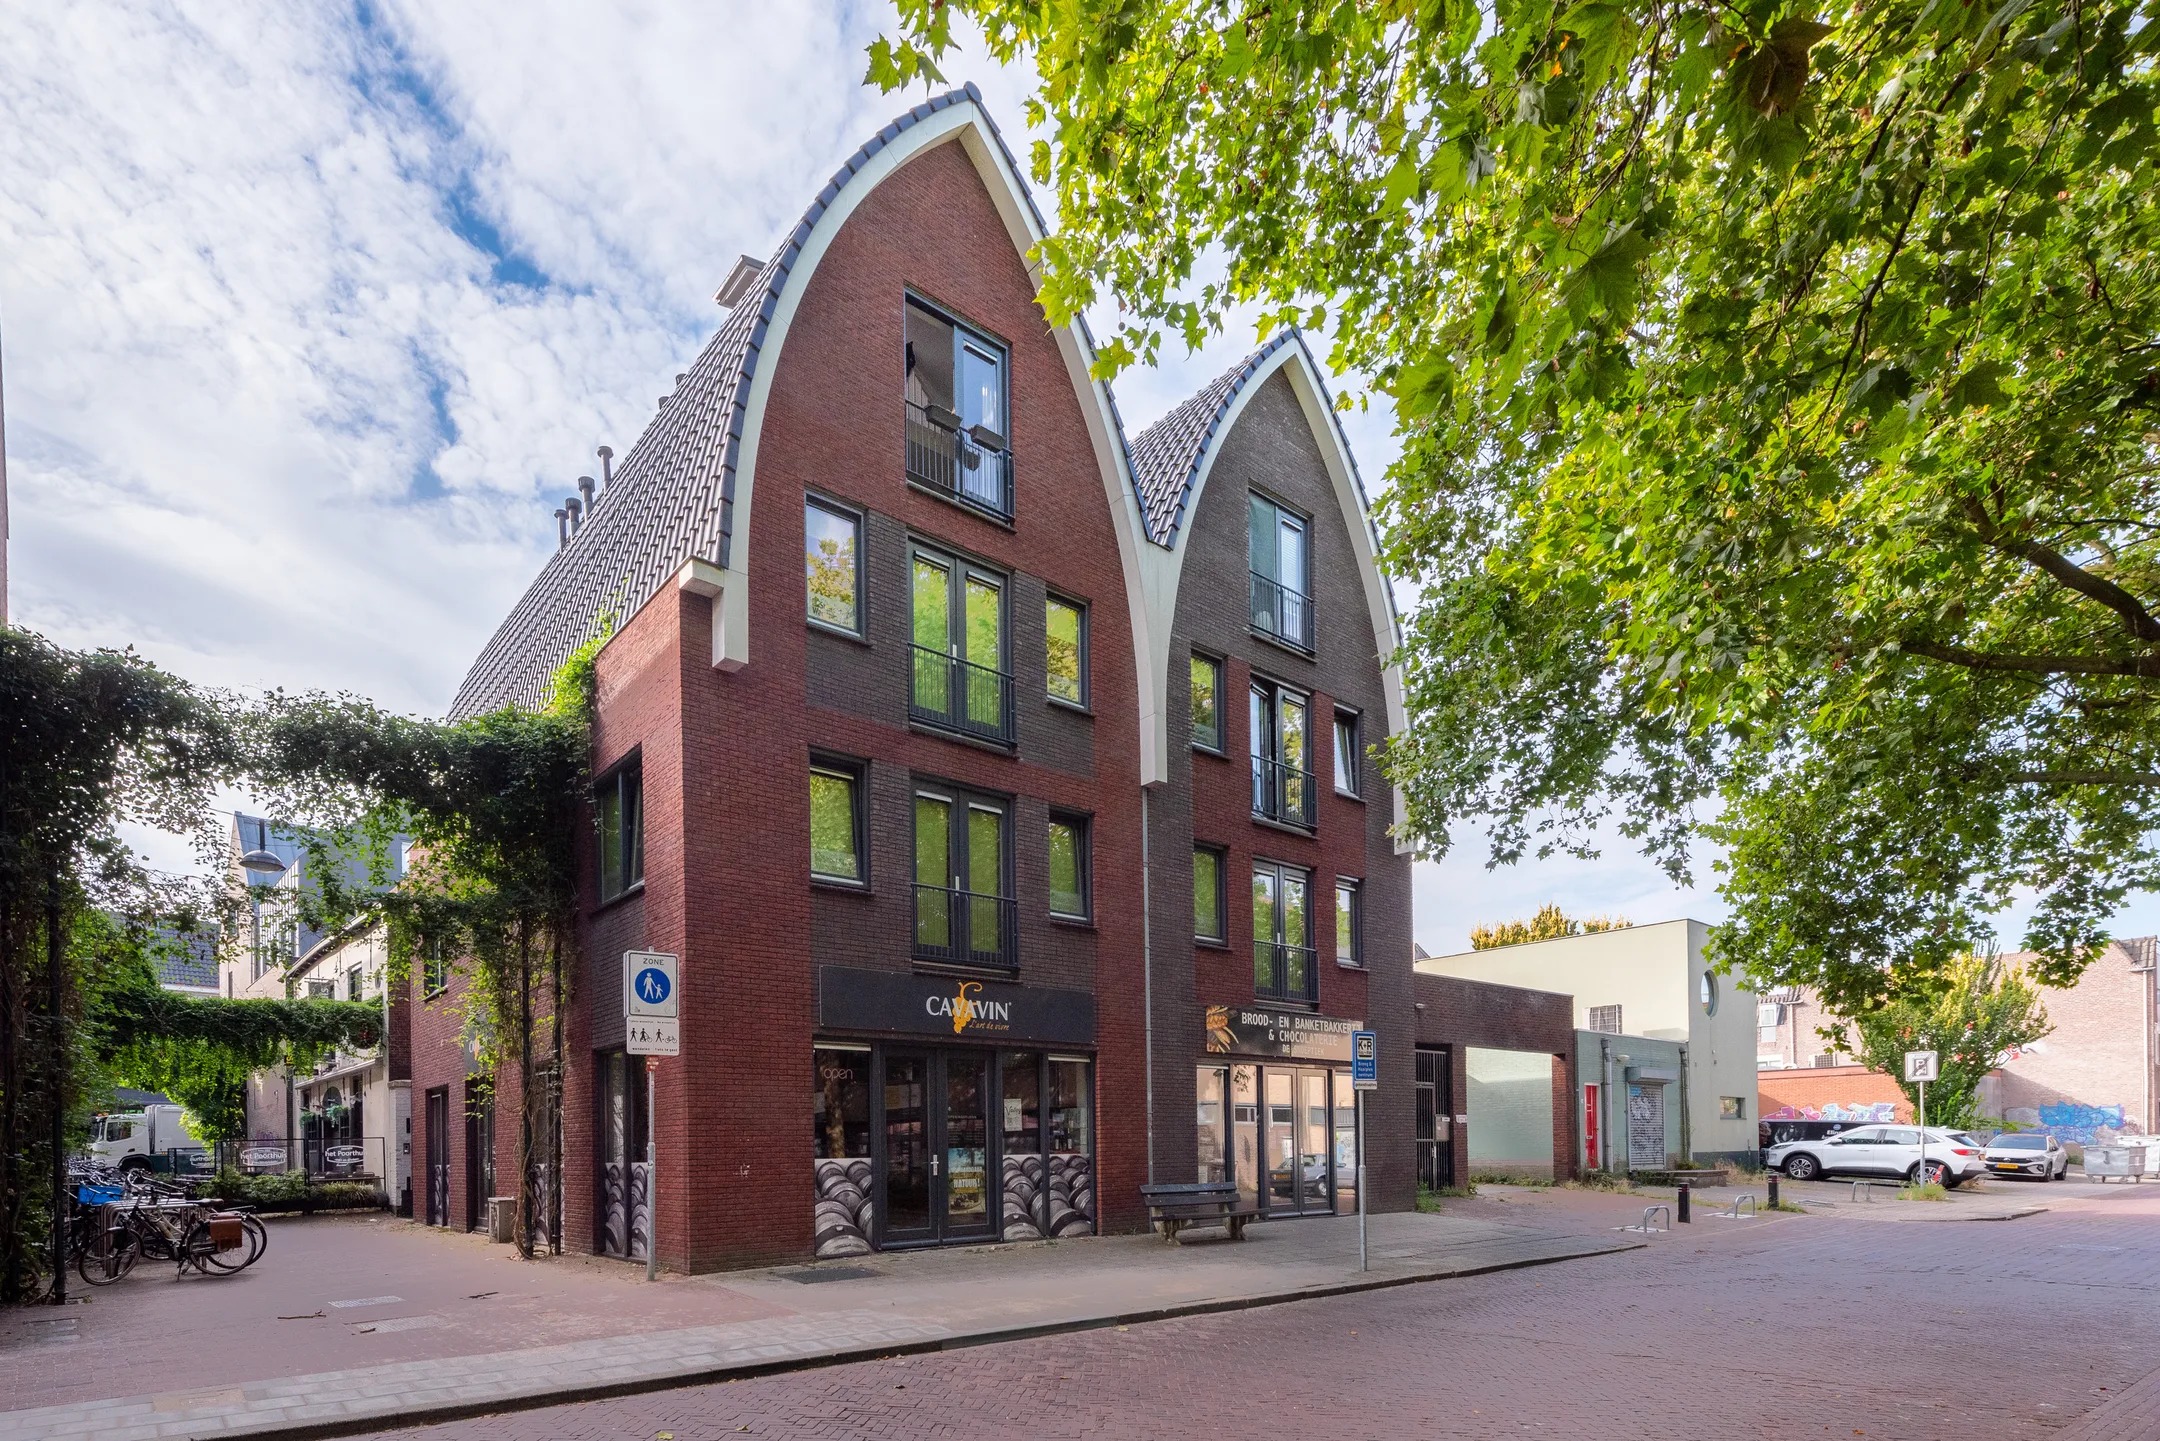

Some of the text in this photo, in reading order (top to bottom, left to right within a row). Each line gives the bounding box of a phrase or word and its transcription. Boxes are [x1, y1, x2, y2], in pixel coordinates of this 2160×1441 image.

[643, 958, 664, 966] ZONE
[926, 996, 1008, 1021] CAVAVIN
[986, 1021, 994, 1030] de
[1241, 1012, 1273, 1026] BROOD-
[1279, 1016, 1290, 1028] EN
[1268, 1029, 1338, 1046] & CHOCOLATERIE
[1282, 1044, 1290, 1053] DE
[823, 1068, 853, 1081] open
[240, 1151, 287, 1160] het Poorthuis
